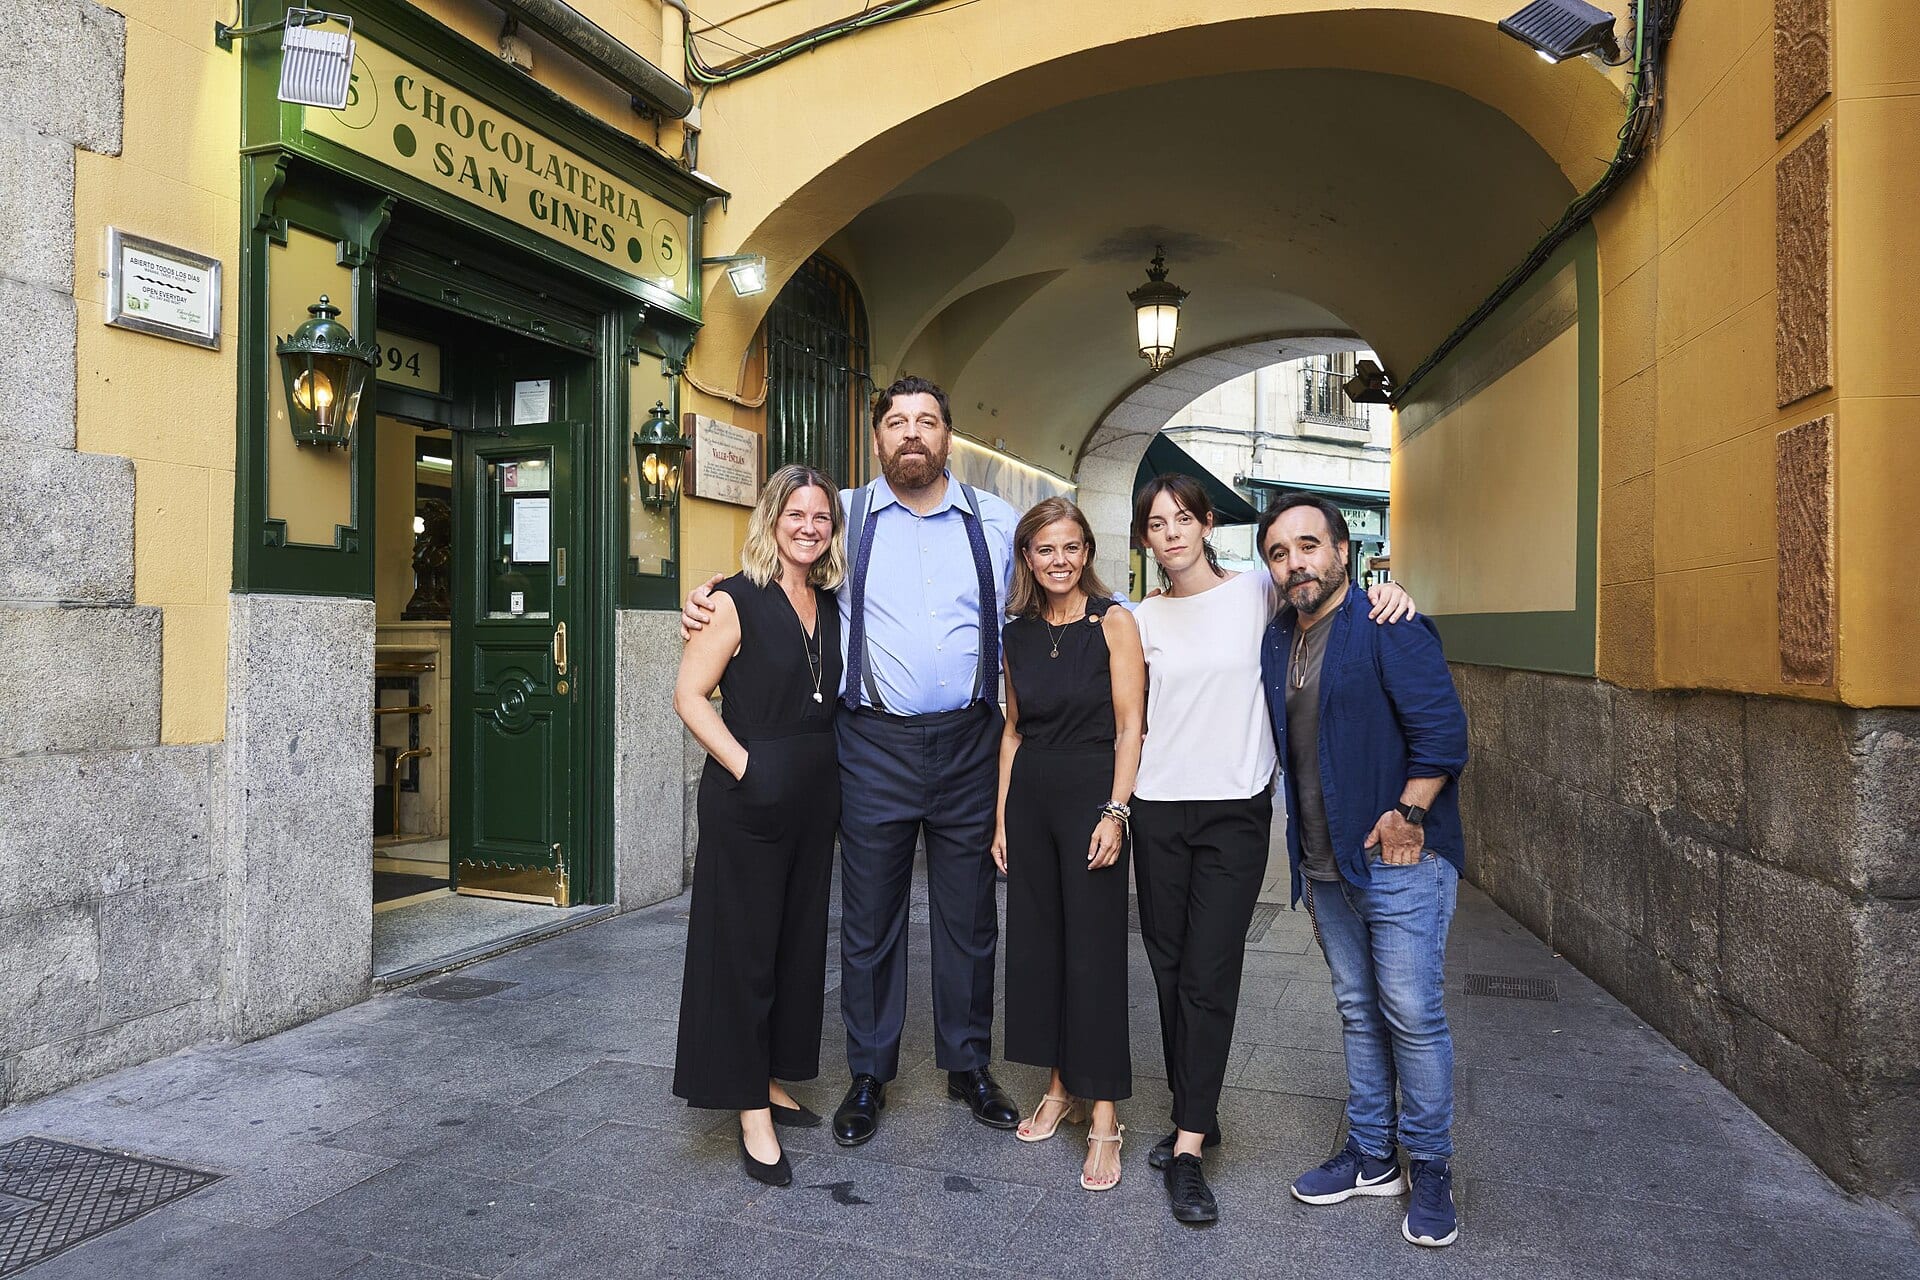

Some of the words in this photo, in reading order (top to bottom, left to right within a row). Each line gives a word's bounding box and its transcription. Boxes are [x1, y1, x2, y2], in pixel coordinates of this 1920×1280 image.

[393, 75, 645, 229] CHOCOLATERIA
[433, 142, 508, 203] SAN
[529, 189, 616, 253] GINES
[661, 234, 673, 261] 5
[130, 257, 155, 270] ABIERTO
[156, 264, 175, 276] TODOS
[176, 270, 187, 279] LOS
[142, 286, 158, 296] OPEN
[159, 290, 187, 303] EVERYDAY
